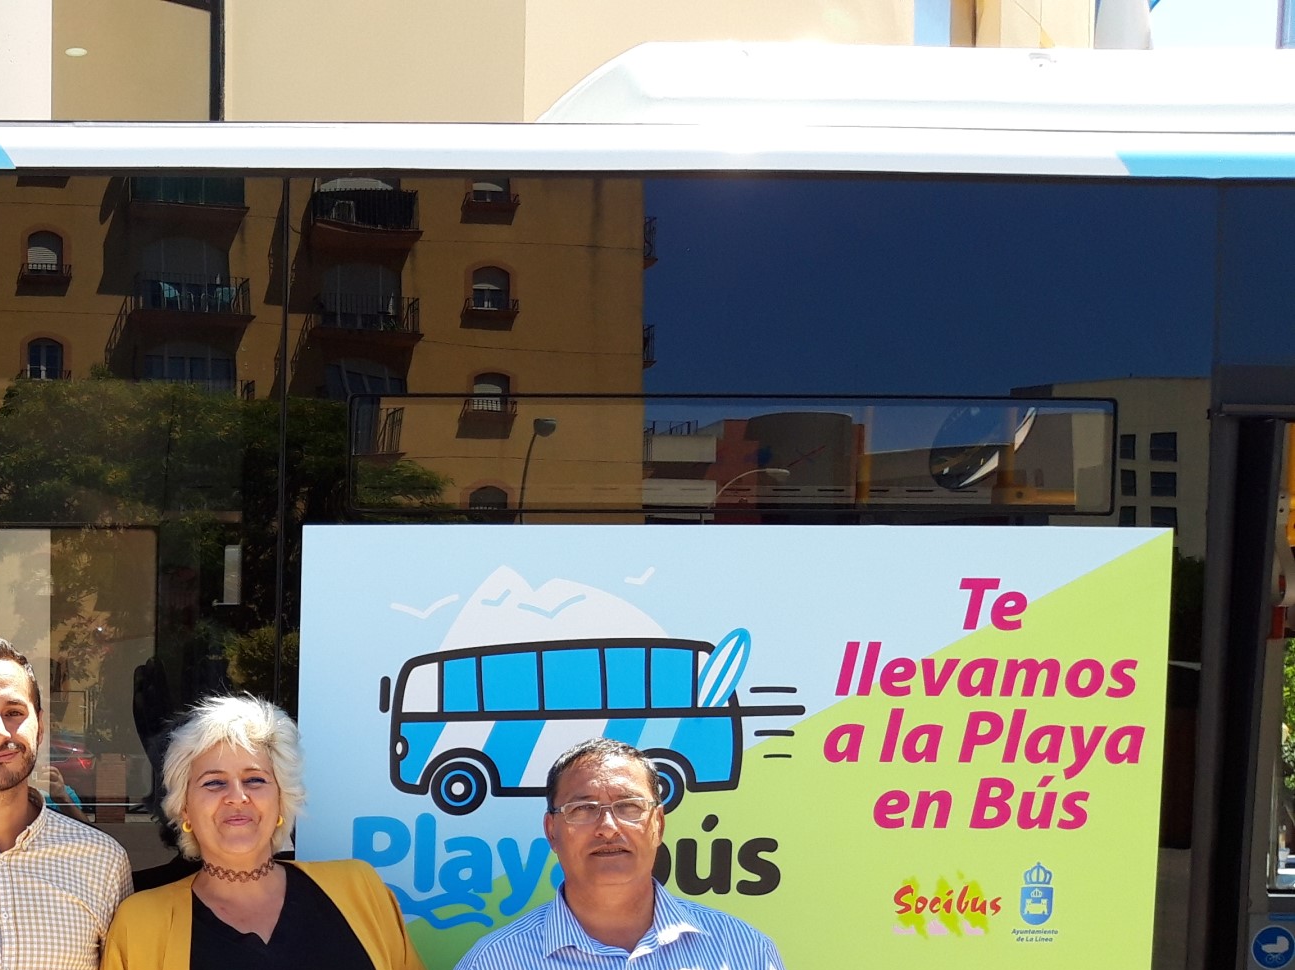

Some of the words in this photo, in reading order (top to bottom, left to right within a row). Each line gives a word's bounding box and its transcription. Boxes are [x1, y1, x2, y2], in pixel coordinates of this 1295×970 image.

[958, 577, 1028, 631] Te
[835, 641, 1138, 698] llevamos
[823, 723, 865, 763] a
[880, 708, 943, 763] la
[959, 710, 1145, 779] Playa
[873, 790, 952, 829] en
[970, 775, 1090, 830] Bús
[1011, 928, 1059, 936] Ayuntamiento
